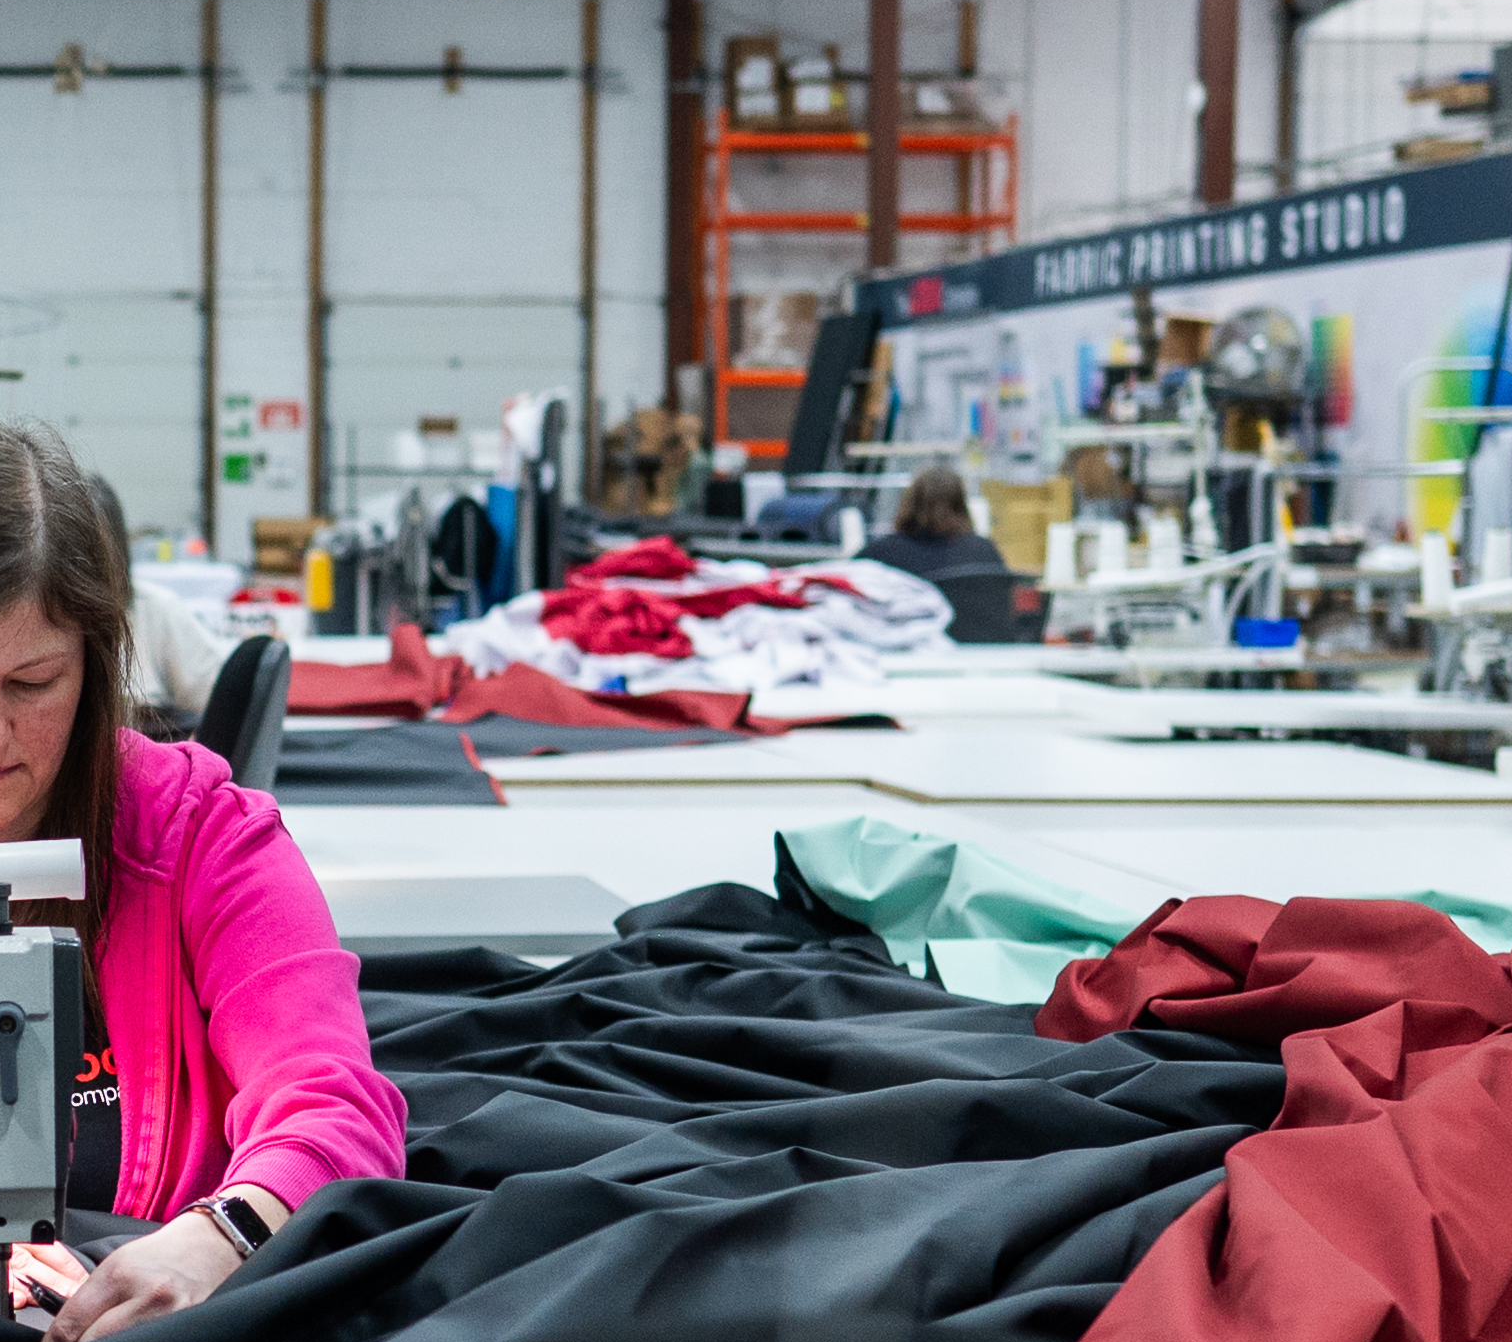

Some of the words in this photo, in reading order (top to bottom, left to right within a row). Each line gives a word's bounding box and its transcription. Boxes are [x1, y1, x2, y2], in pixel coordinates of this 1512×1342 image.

[1033, 238, 1122, 299] FABRIC
[1128, 210, 1268, 284] PRINTING
[1280, 184, 1407, 260] STUDIO
